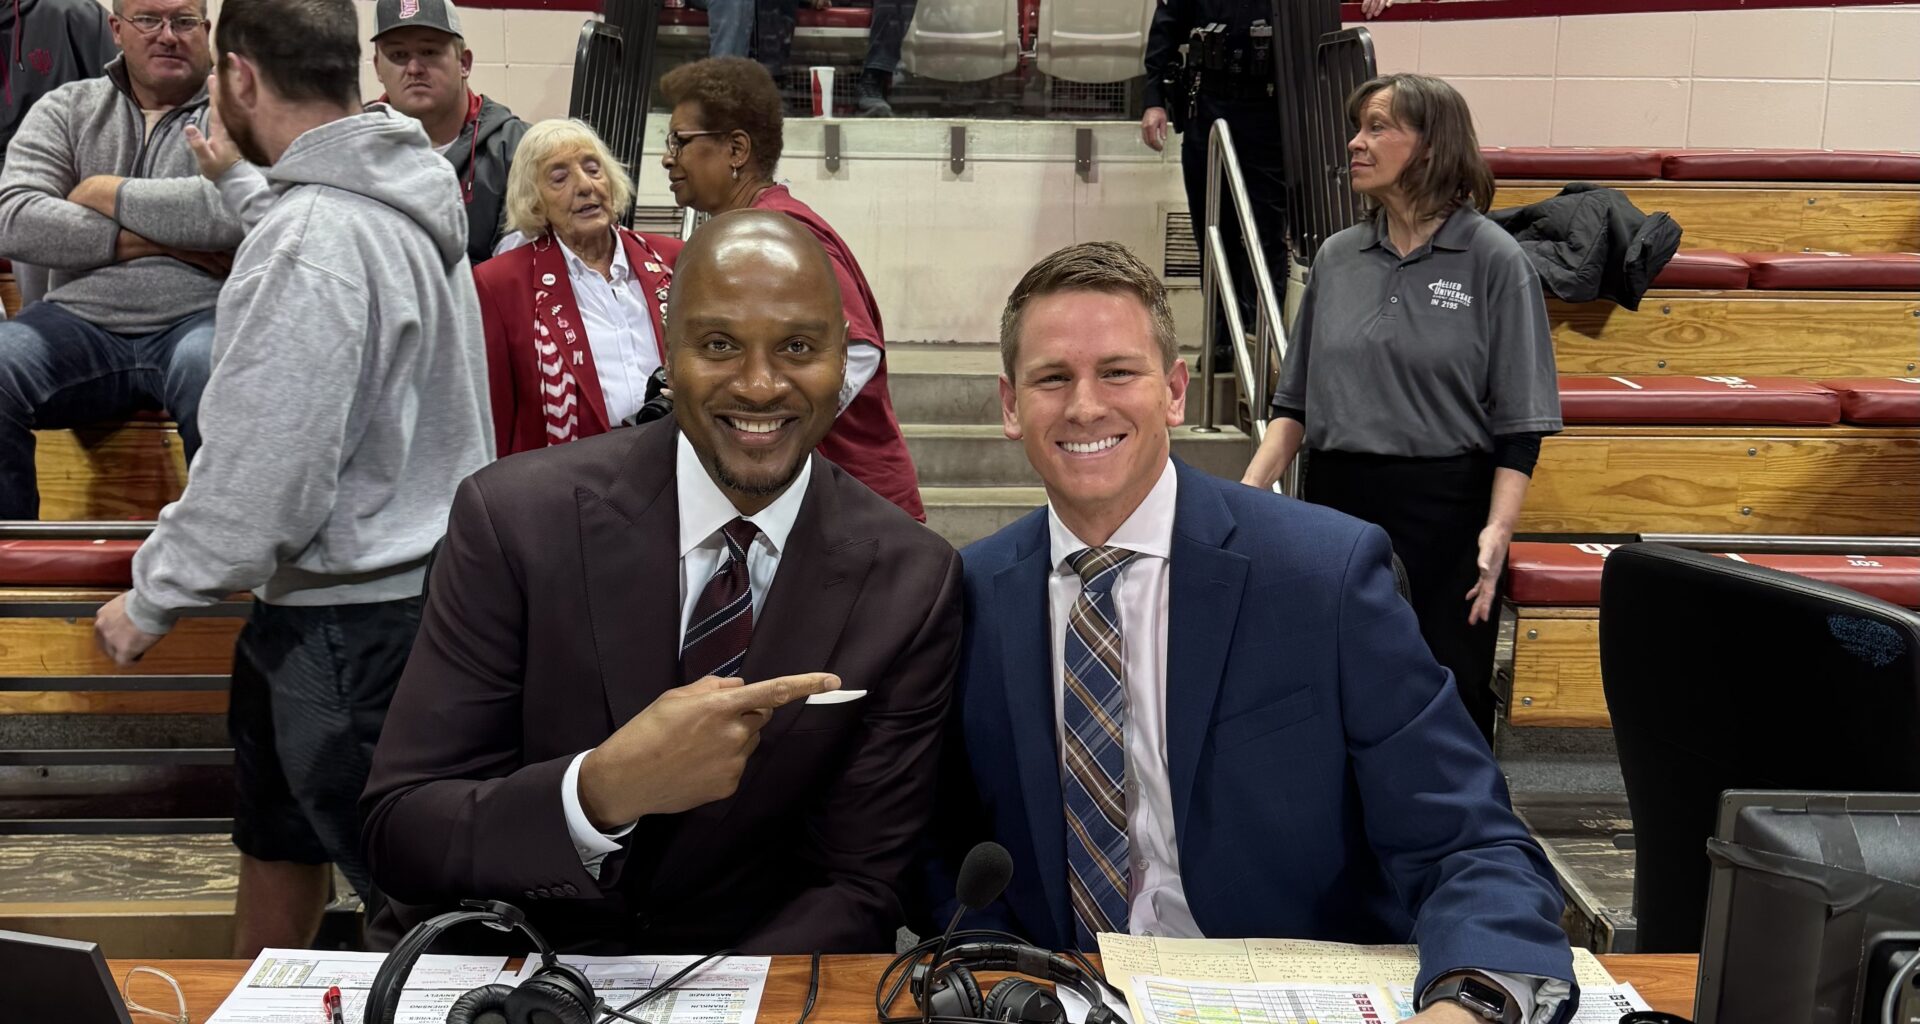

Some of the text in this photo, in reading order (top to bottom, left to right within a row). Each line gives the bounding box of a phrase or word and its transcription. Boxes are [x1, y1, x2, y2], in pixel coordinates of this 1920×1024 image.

[1437, 278, 1462, 291] ALLIED
[1434, 287, 1473, 304] UNIVERSAL
[1430, 298, 1440, 306] IN
[1441, 300, 1459, 310] 2195
[1847, 559, 1883, 568] 102
